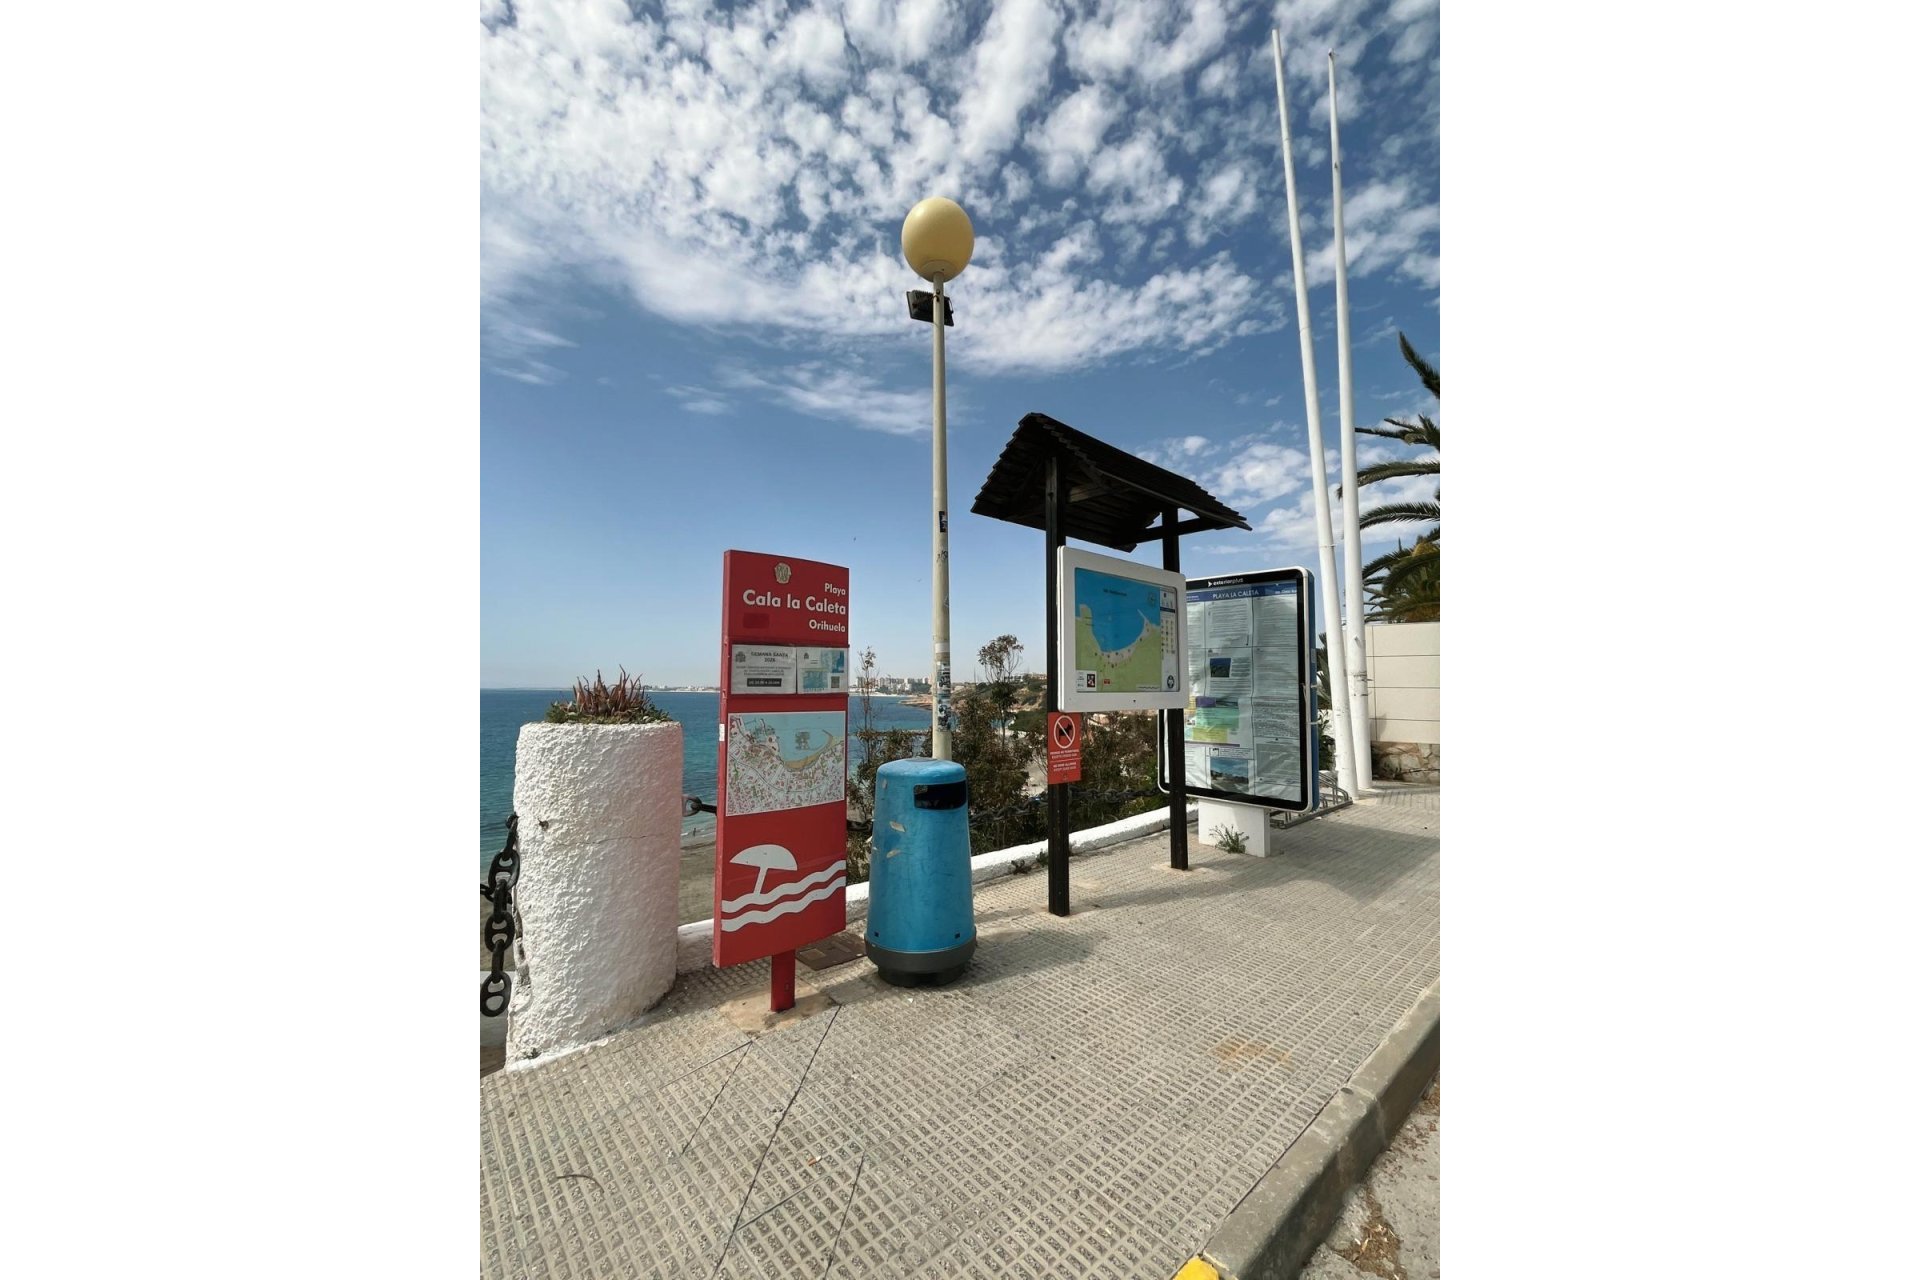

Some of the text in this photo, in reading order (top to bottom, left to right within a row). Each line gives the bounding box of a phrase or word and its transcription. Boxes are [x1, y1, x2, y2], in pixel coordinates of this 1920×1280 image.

[824, 583, 846, 596] Playa
[1237, 589, 1259, 597] CALETA
[743, 589, 846, 615] Cala la Caleta
[809, 620, 845, 632] Orihuela
